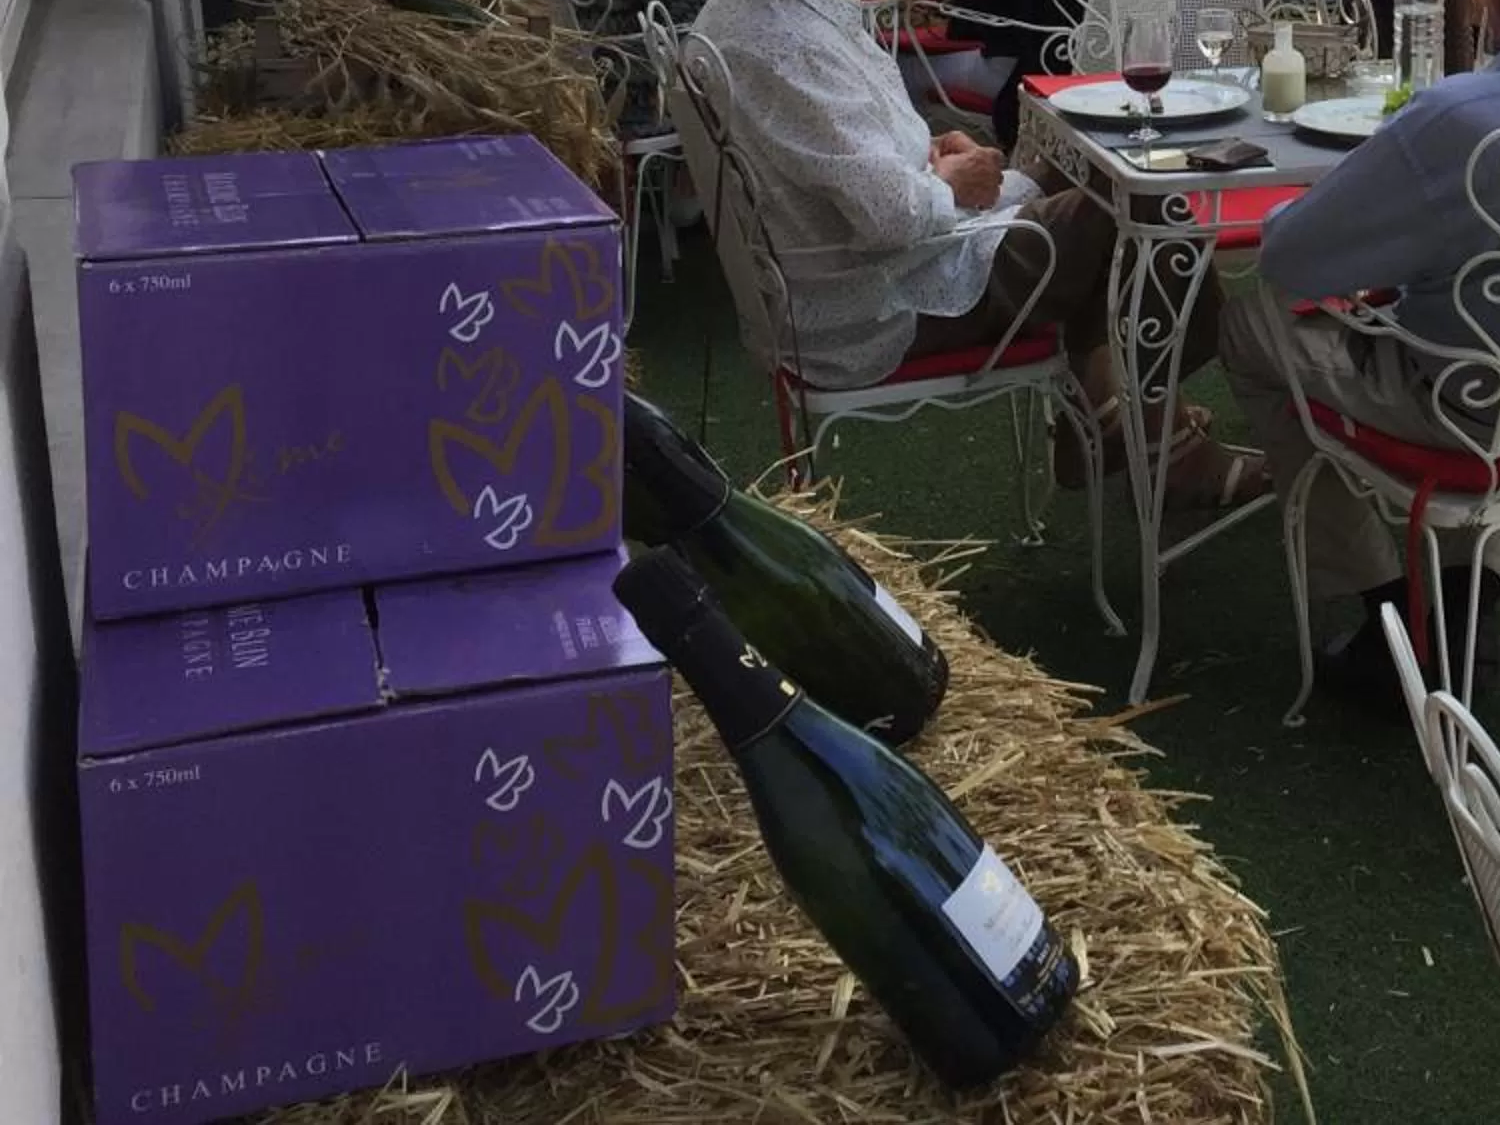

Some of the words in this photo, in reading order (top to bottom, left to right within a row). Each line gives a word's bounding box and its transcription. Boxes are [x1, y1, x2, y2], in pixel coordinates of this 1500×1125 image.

[140, 273, 192, 293] 750ml
[122, 544, 352, 590] CHAMPAGNE
[143, 765, 201, 789] 750ml
[131, 1041, 383, 1113] CHAMPAGNE
